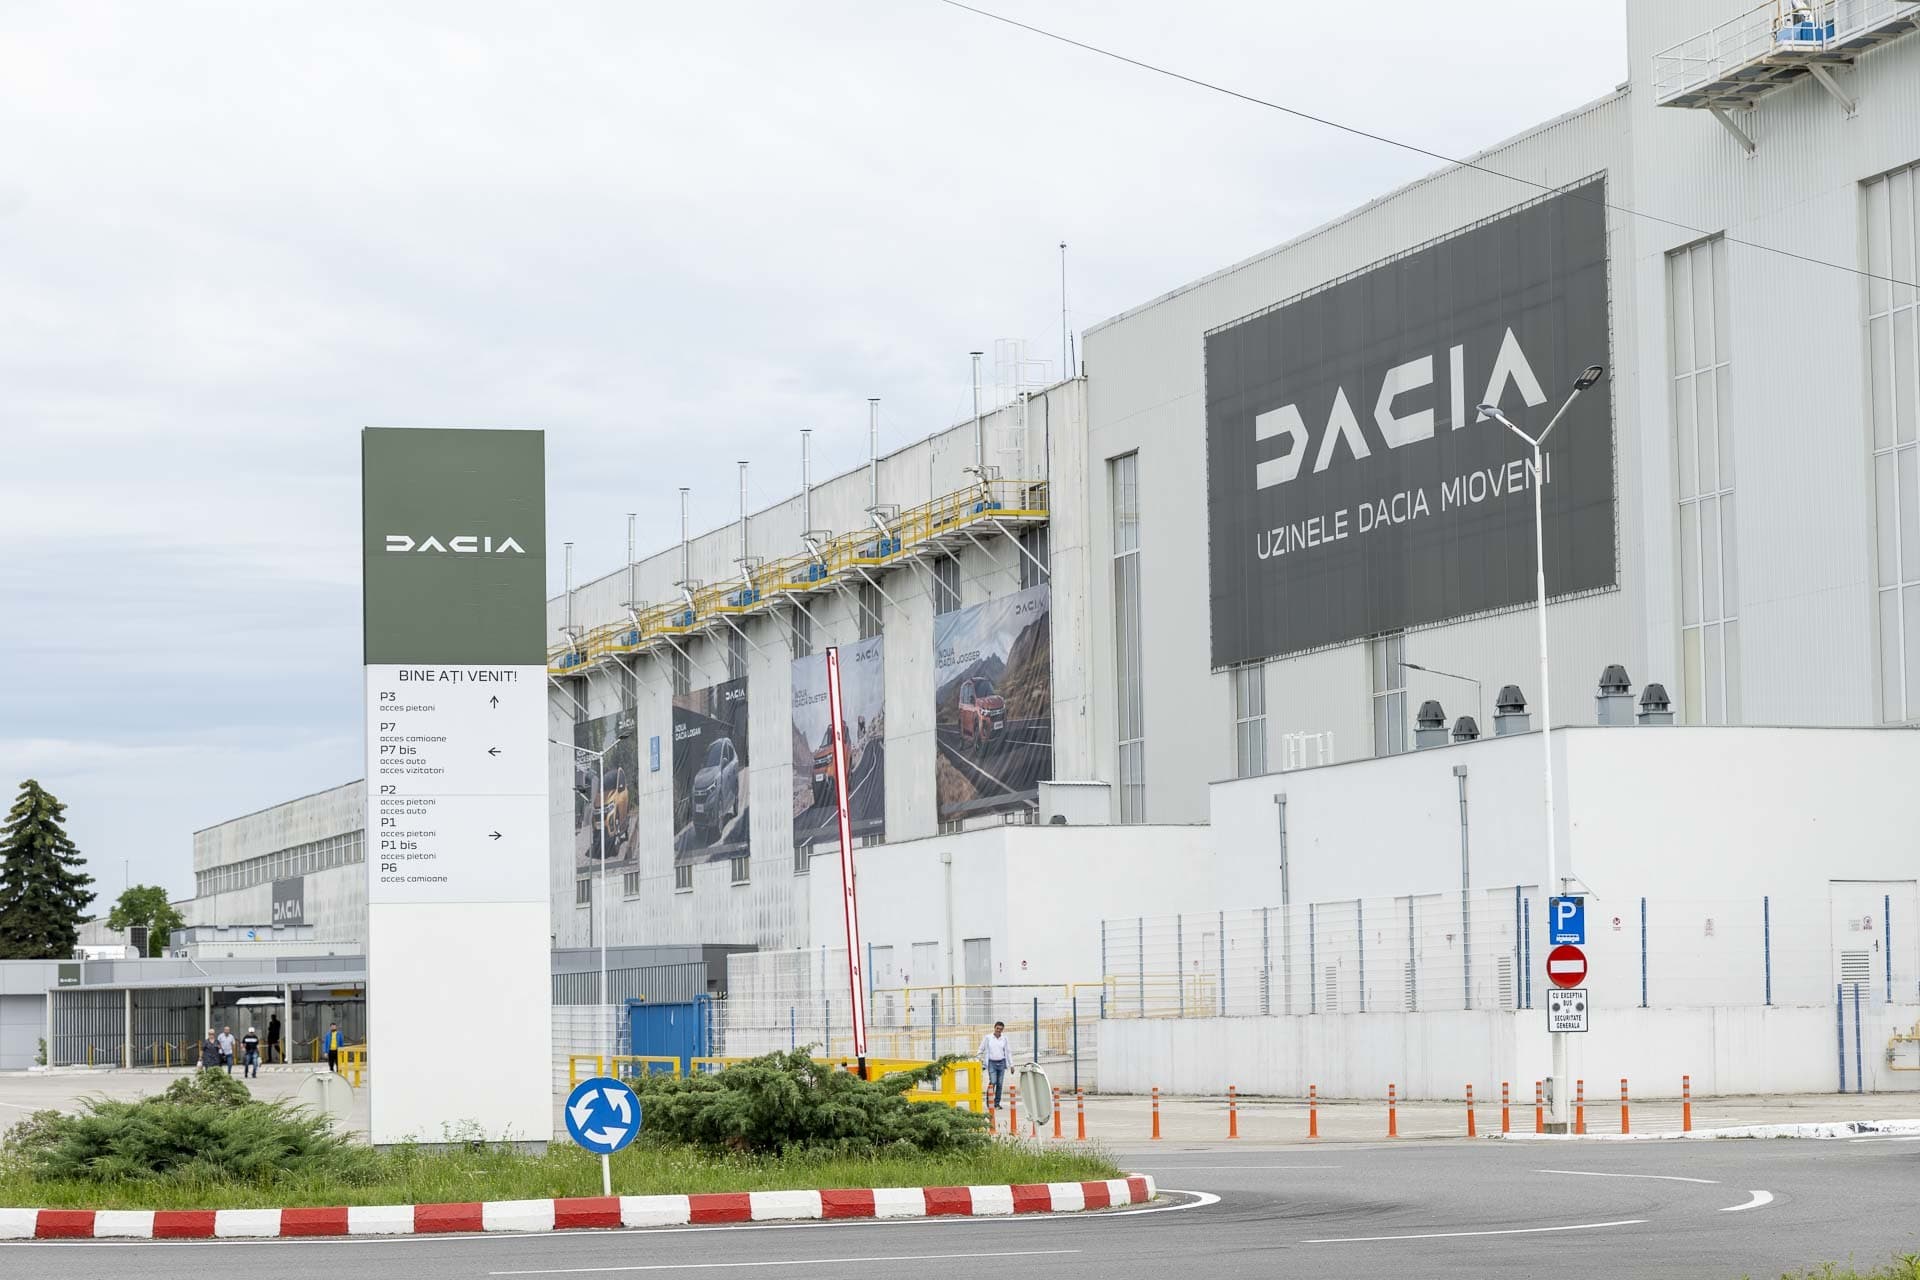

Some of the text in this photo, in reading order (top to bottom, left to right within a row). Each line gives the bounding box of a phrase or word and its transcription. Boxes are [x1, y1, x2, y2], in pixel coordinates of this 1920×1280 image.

[1255, 326, 1548, 490] DACIA
[1256, 452, 1551, 560] UZINELE DACIA MIOVENI
[385, 535, 526, 553] DACIA
[855, 648, 879, 662] DACIA
[399, 670, 435, 682] BINE
[468, 670, 517, 682] VENIT!
[380, 691, 396, 701] P3
[725, 689, 745, 700] DACIA
[405, 704, 435, 712] pietoni
[380, 722, 396, 732] P7
[380, 745, 417, 755] P7 bis
[380, 785, 396, 794] P2
[406, 798, 436, 806] pietoni
[381, 818, 397, 827] P1
[406, 830, 436, 838] pietoni
[381, 840, 417, 850] P1 bis
[406, 852, 437, 861] pietoni
[381, 863, 397, 873] P6
[406, 875, 448, 883] camioane
[273, 899, 302, 921] DACIA
[1558, 901, 1577, 930] P
[1554, 1014, 1582, 1022] SECURITATE
